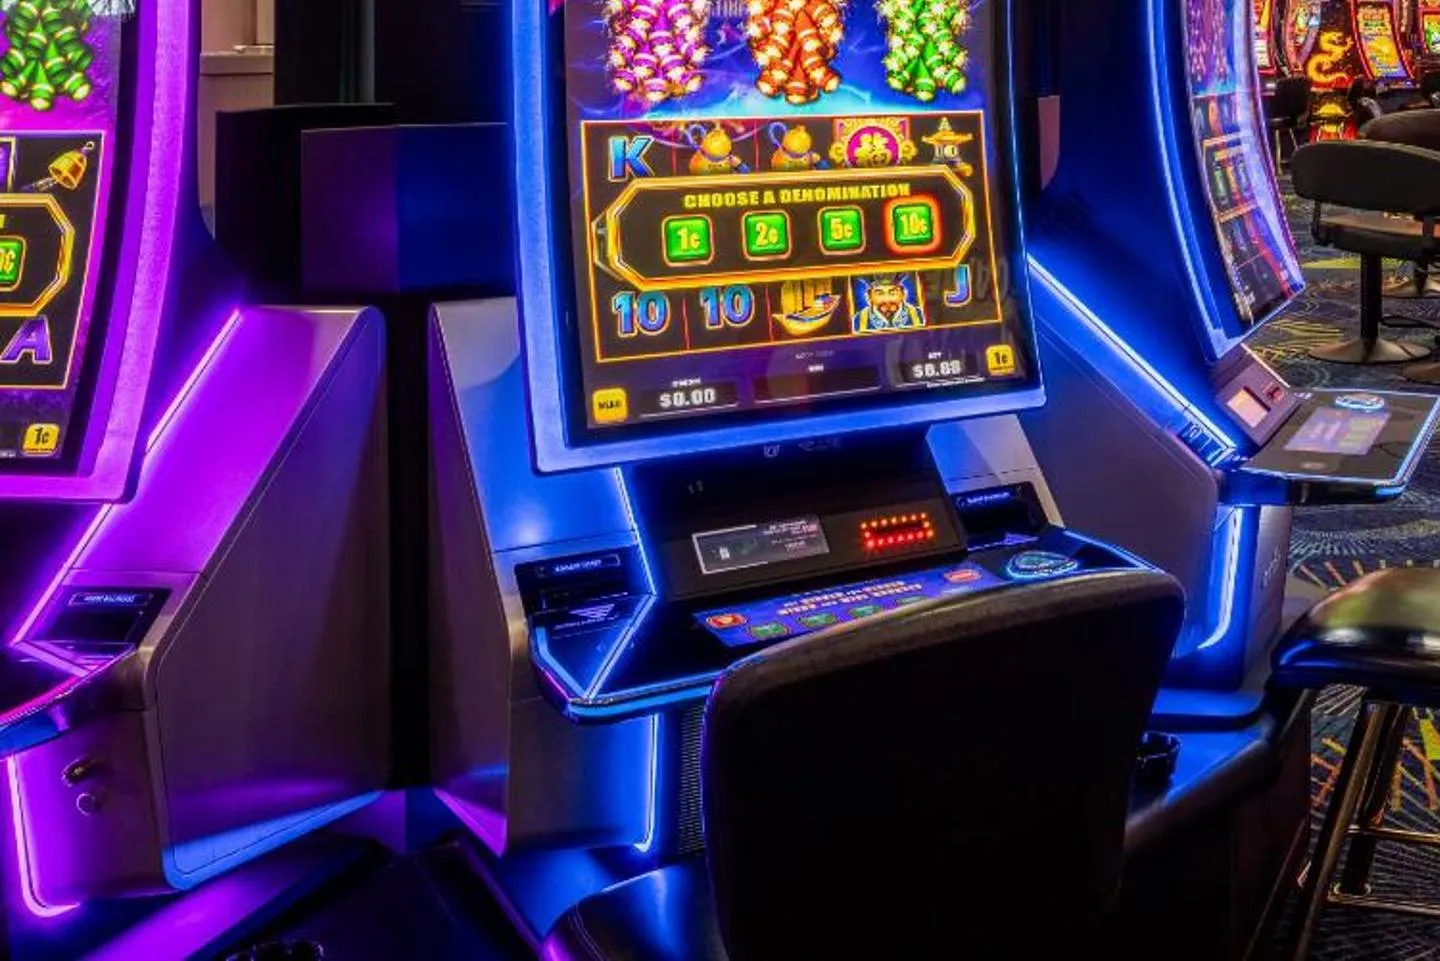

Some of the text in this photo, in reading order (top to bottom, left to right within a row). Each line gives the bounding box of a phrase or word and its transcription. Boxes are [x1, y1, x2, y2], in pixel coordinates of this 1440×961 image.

[608, 135, 655, 181] K
[684, 183, 911, 209] CHOOSE A DENOMINATION
[699, 283, 756, 331] 10
[943, 263, 973, 308] J
[610, 290, 672, 338] 10
[0, 314, 52, 364] A
